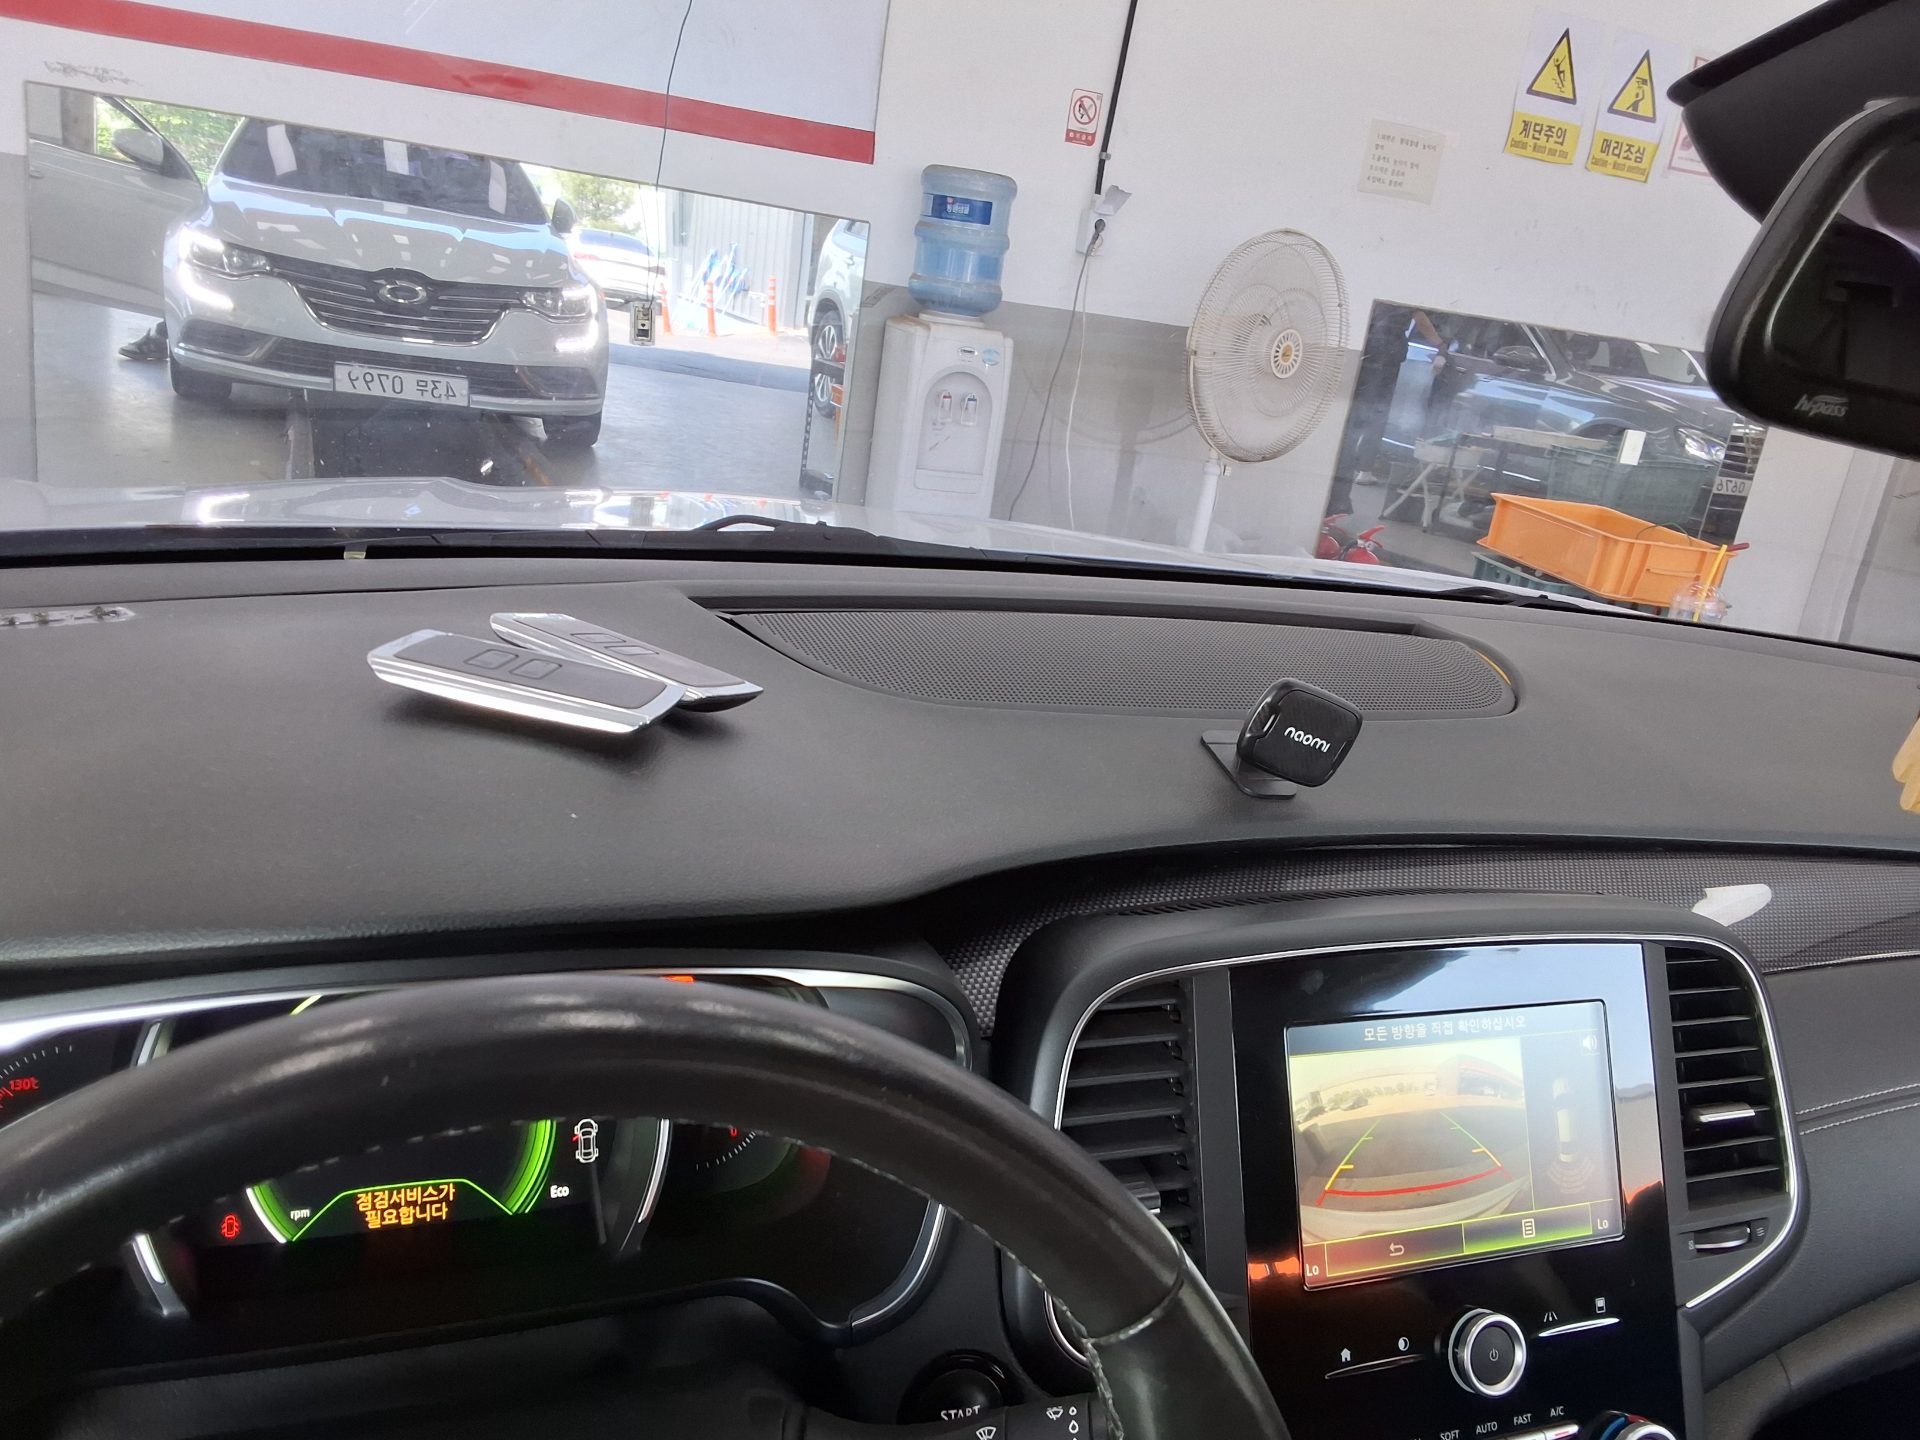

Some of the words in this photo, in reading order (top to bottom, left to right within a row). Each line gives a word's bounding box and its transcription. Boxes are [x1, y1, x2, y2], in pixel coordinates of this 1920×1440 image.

[1519, 120, 1567, 146] 계단주의
[1600, 138, 1646, 164] 머리조심
[1284, 727, 1331, 752] naomi
[1364, 1027, 1388, 1042] 모든
[1391, 1023, 1428, 1041] 방향을
[1431, 1021, 1454, 1036] 직접
[1456, 1014, 1527, 1034] 확인하십시오
[356, 1183, 456, 1212] 점검서비스가
[550, 1184, 570, 1199] Eco
[289, 1208, 311, 1222] rpm
[365, 1202, 449, 1230] 필요합니다
[1597, 1217, 1609, 1230] Lo
[1305, 1263, 1320, 1277] Lo
[1513, 1413, 1532, 1426] FAST
[1550, 1406, 1565, 1418] A/C
[1475, 1421, 1498, 1435] AUTO
